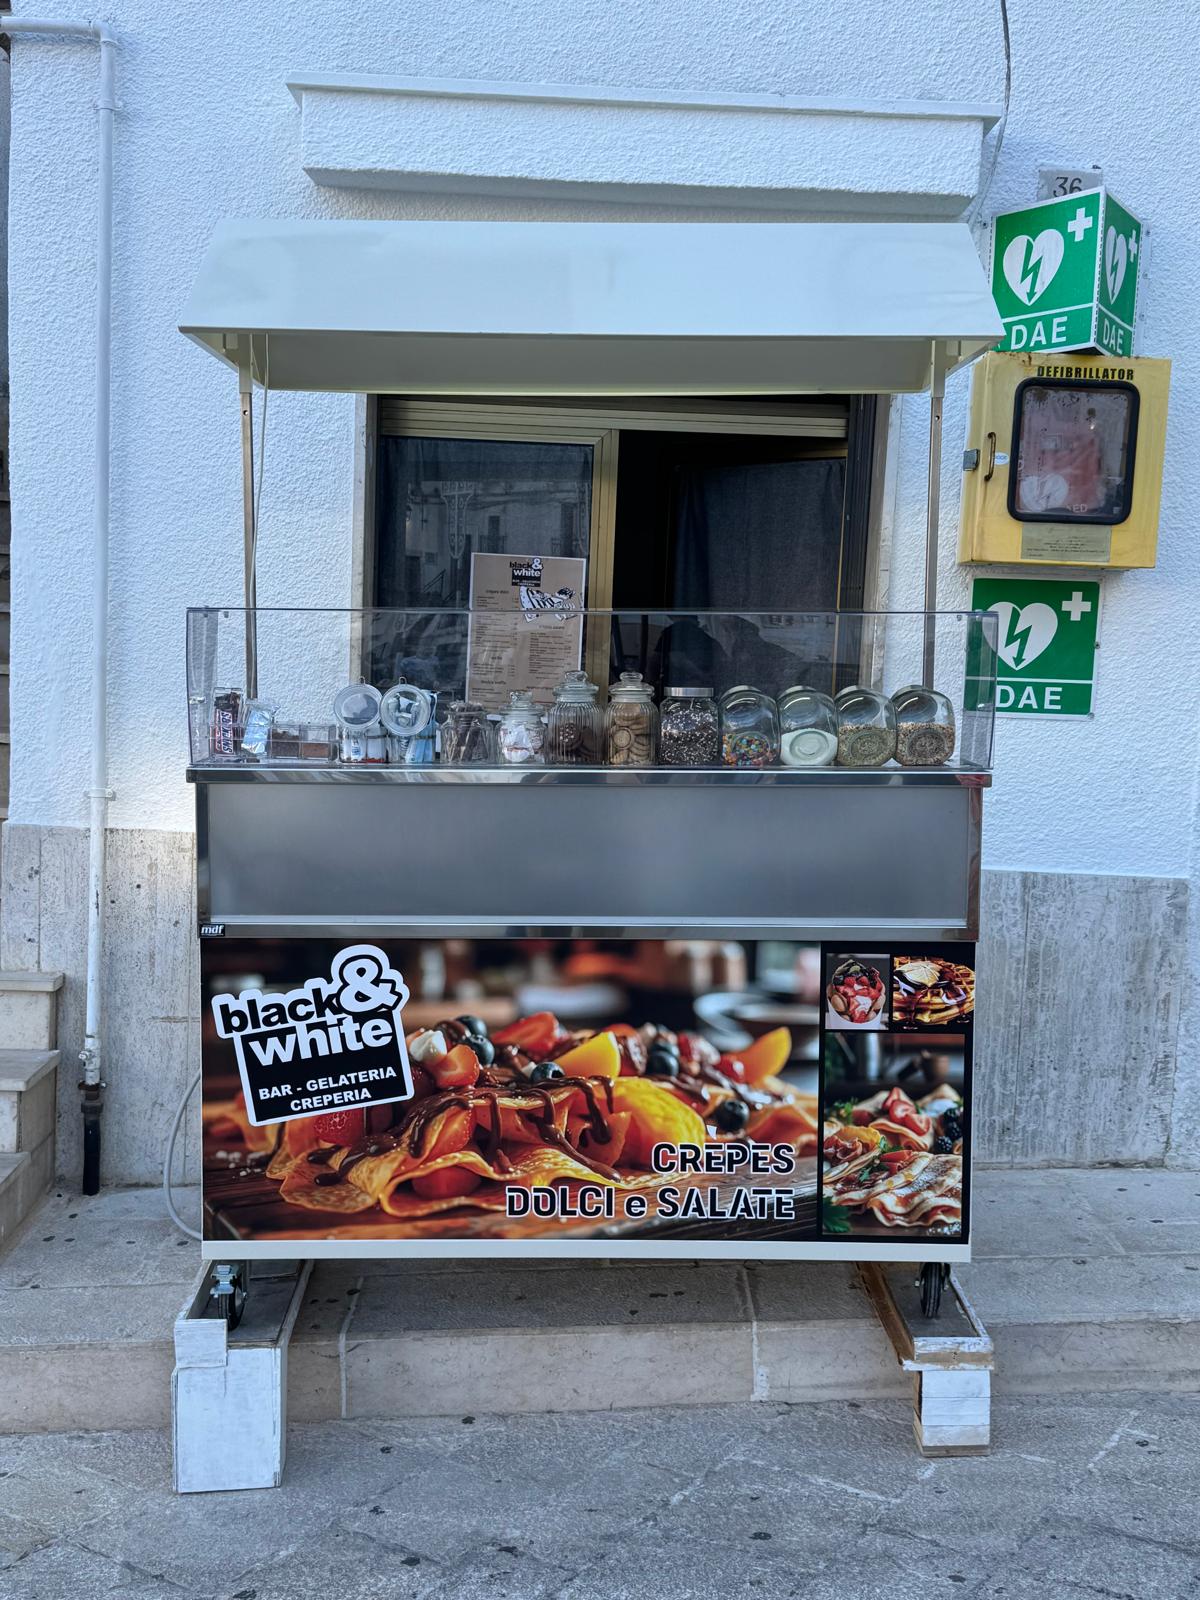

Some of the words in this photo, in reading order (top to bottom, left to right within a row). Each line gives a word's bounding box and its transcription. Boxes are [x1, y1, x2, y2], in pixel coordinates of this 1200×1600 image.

[1053, 176, 1082, 197] 36
[1010, 316, 1068, 350] DAE
[1102, 317, 1125, 354] DAE
[1037, 366, 1134, 380] DEFIBRILLATOR
[513, 569, 541, 577] white
[996, 685, 1063, 710] DAE
[201, 925, 224, 934] mdf
[249, 1016, 393, 1067] white
[258, 1084, 293, 1100] BAR
[306, 1066, 397, 1092] GELATERIA
[290, 1087, 372, 1112] CREPERIA
[652, 1142, 796, 1175] CREPES
[505, 1185, 615, 1218] DOLCI
[624, 1195, 647, 1219] e
[657, 1186, 796, 1220] SALATE
